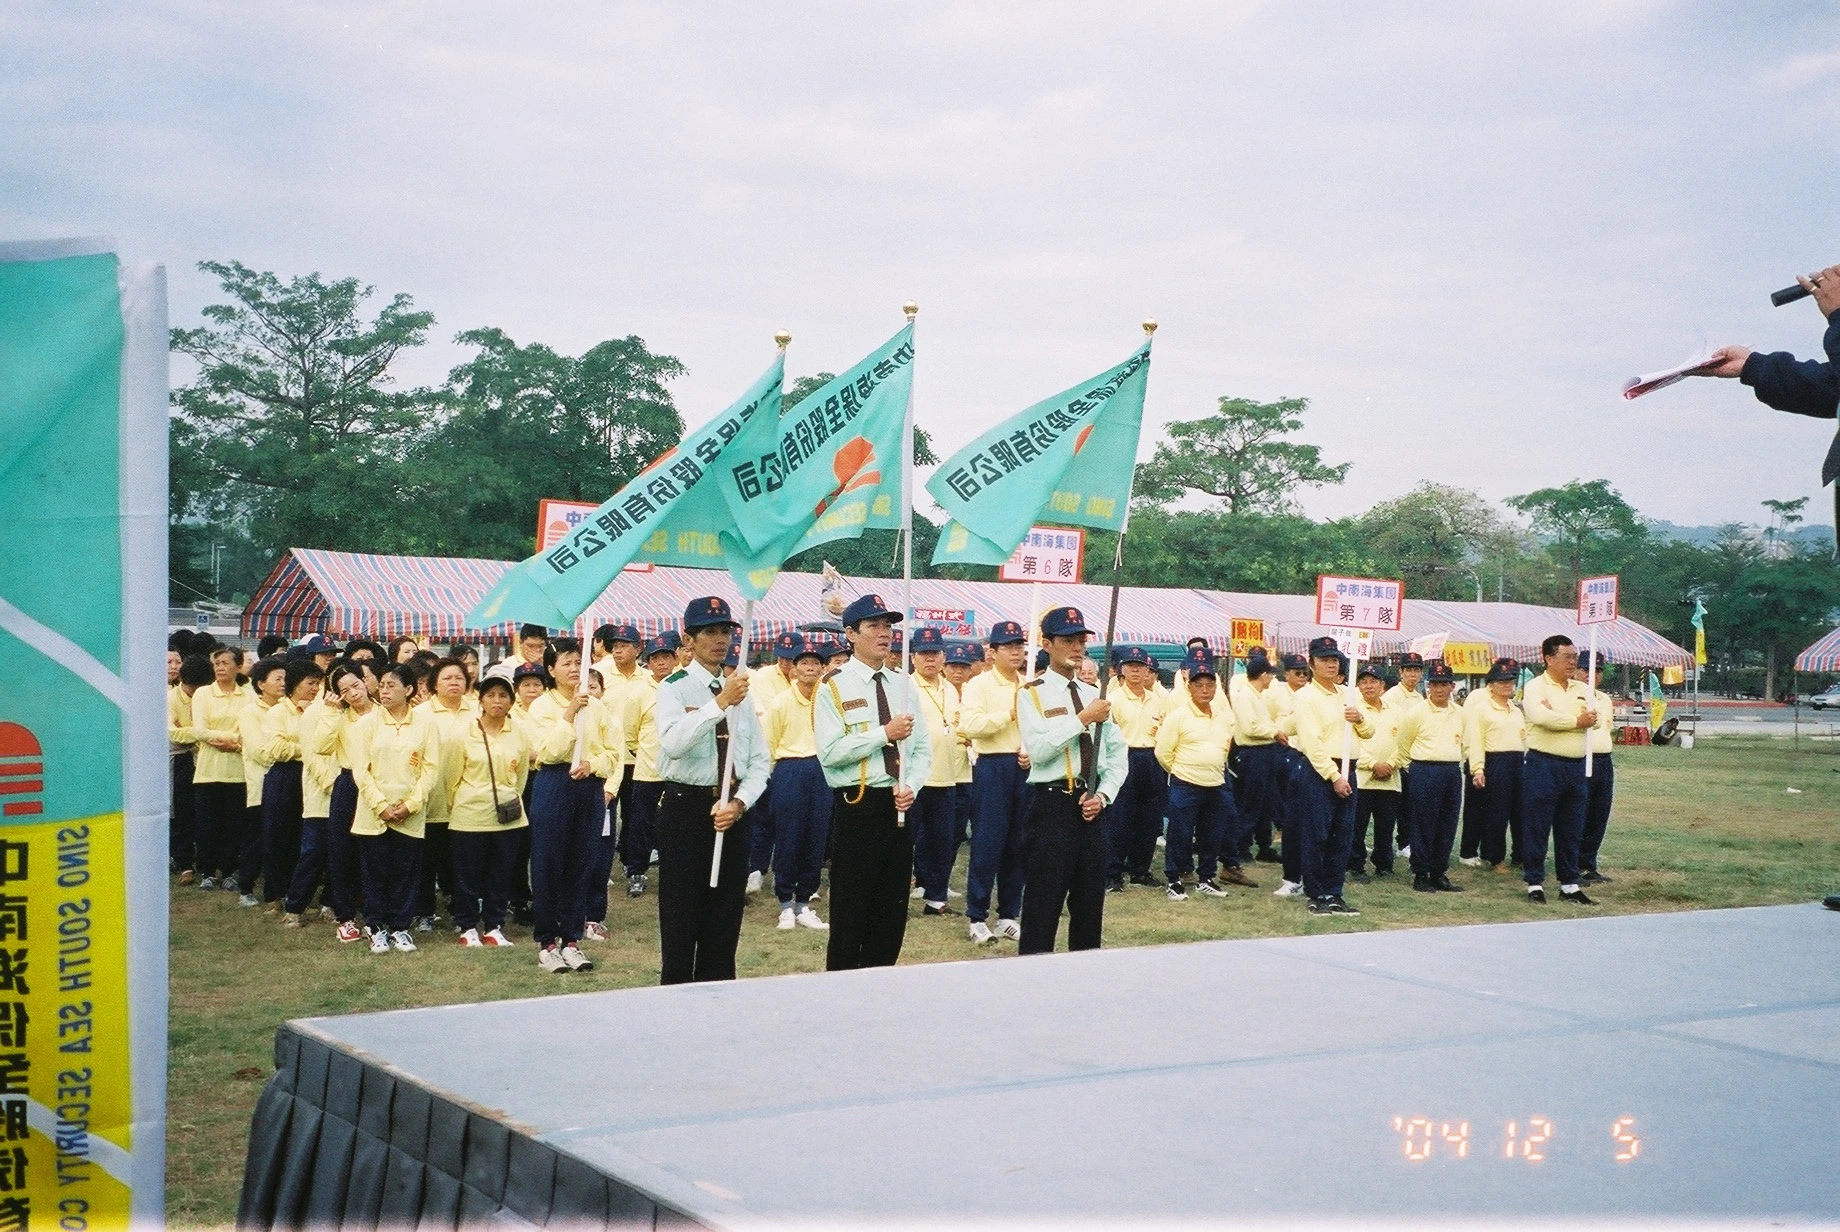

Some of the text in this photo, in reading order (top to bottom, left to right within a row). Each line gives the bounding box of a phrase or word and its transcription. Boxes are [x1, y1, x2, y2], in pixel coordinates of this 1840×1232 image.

[1336, 583, 1397, 599] 中南海集團
